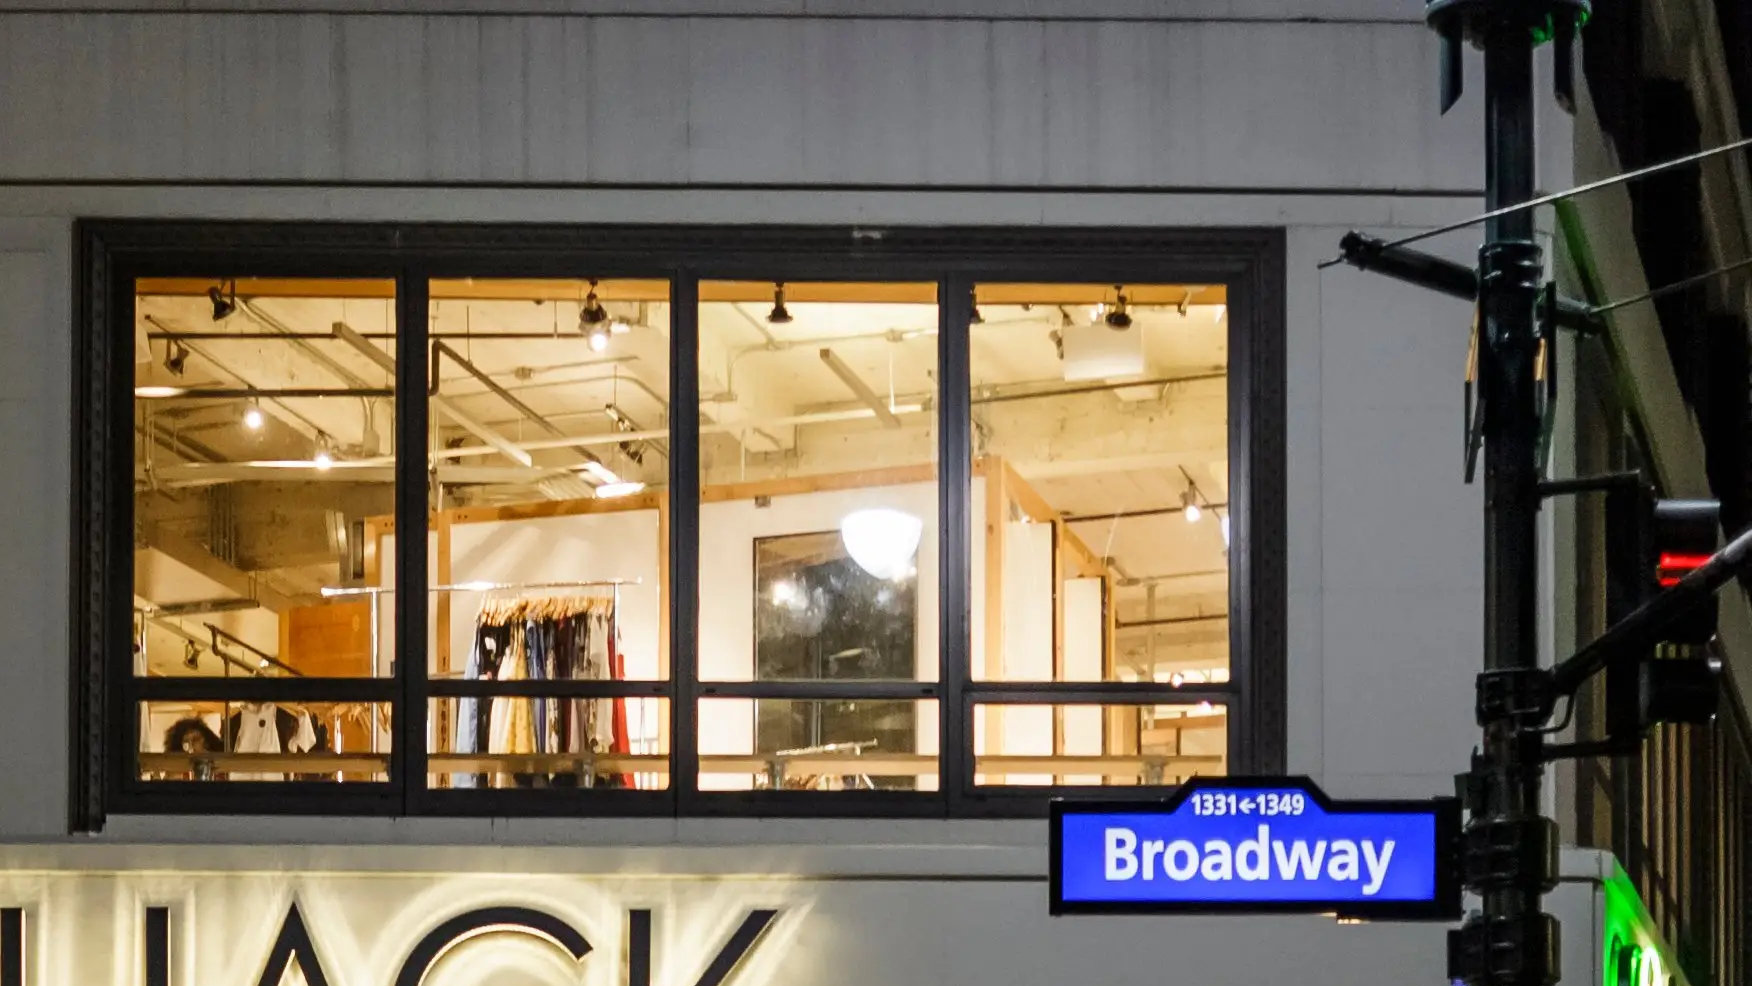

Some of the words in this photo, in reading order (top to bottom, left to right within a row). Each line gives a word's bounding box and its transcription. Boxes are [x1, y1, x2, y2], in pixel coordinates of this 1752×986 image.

[1191, 793, 1238, 816] 1331
[1256, 793, 1305, 816] 1349
[1104, 825, 1396, 895] Broadway
